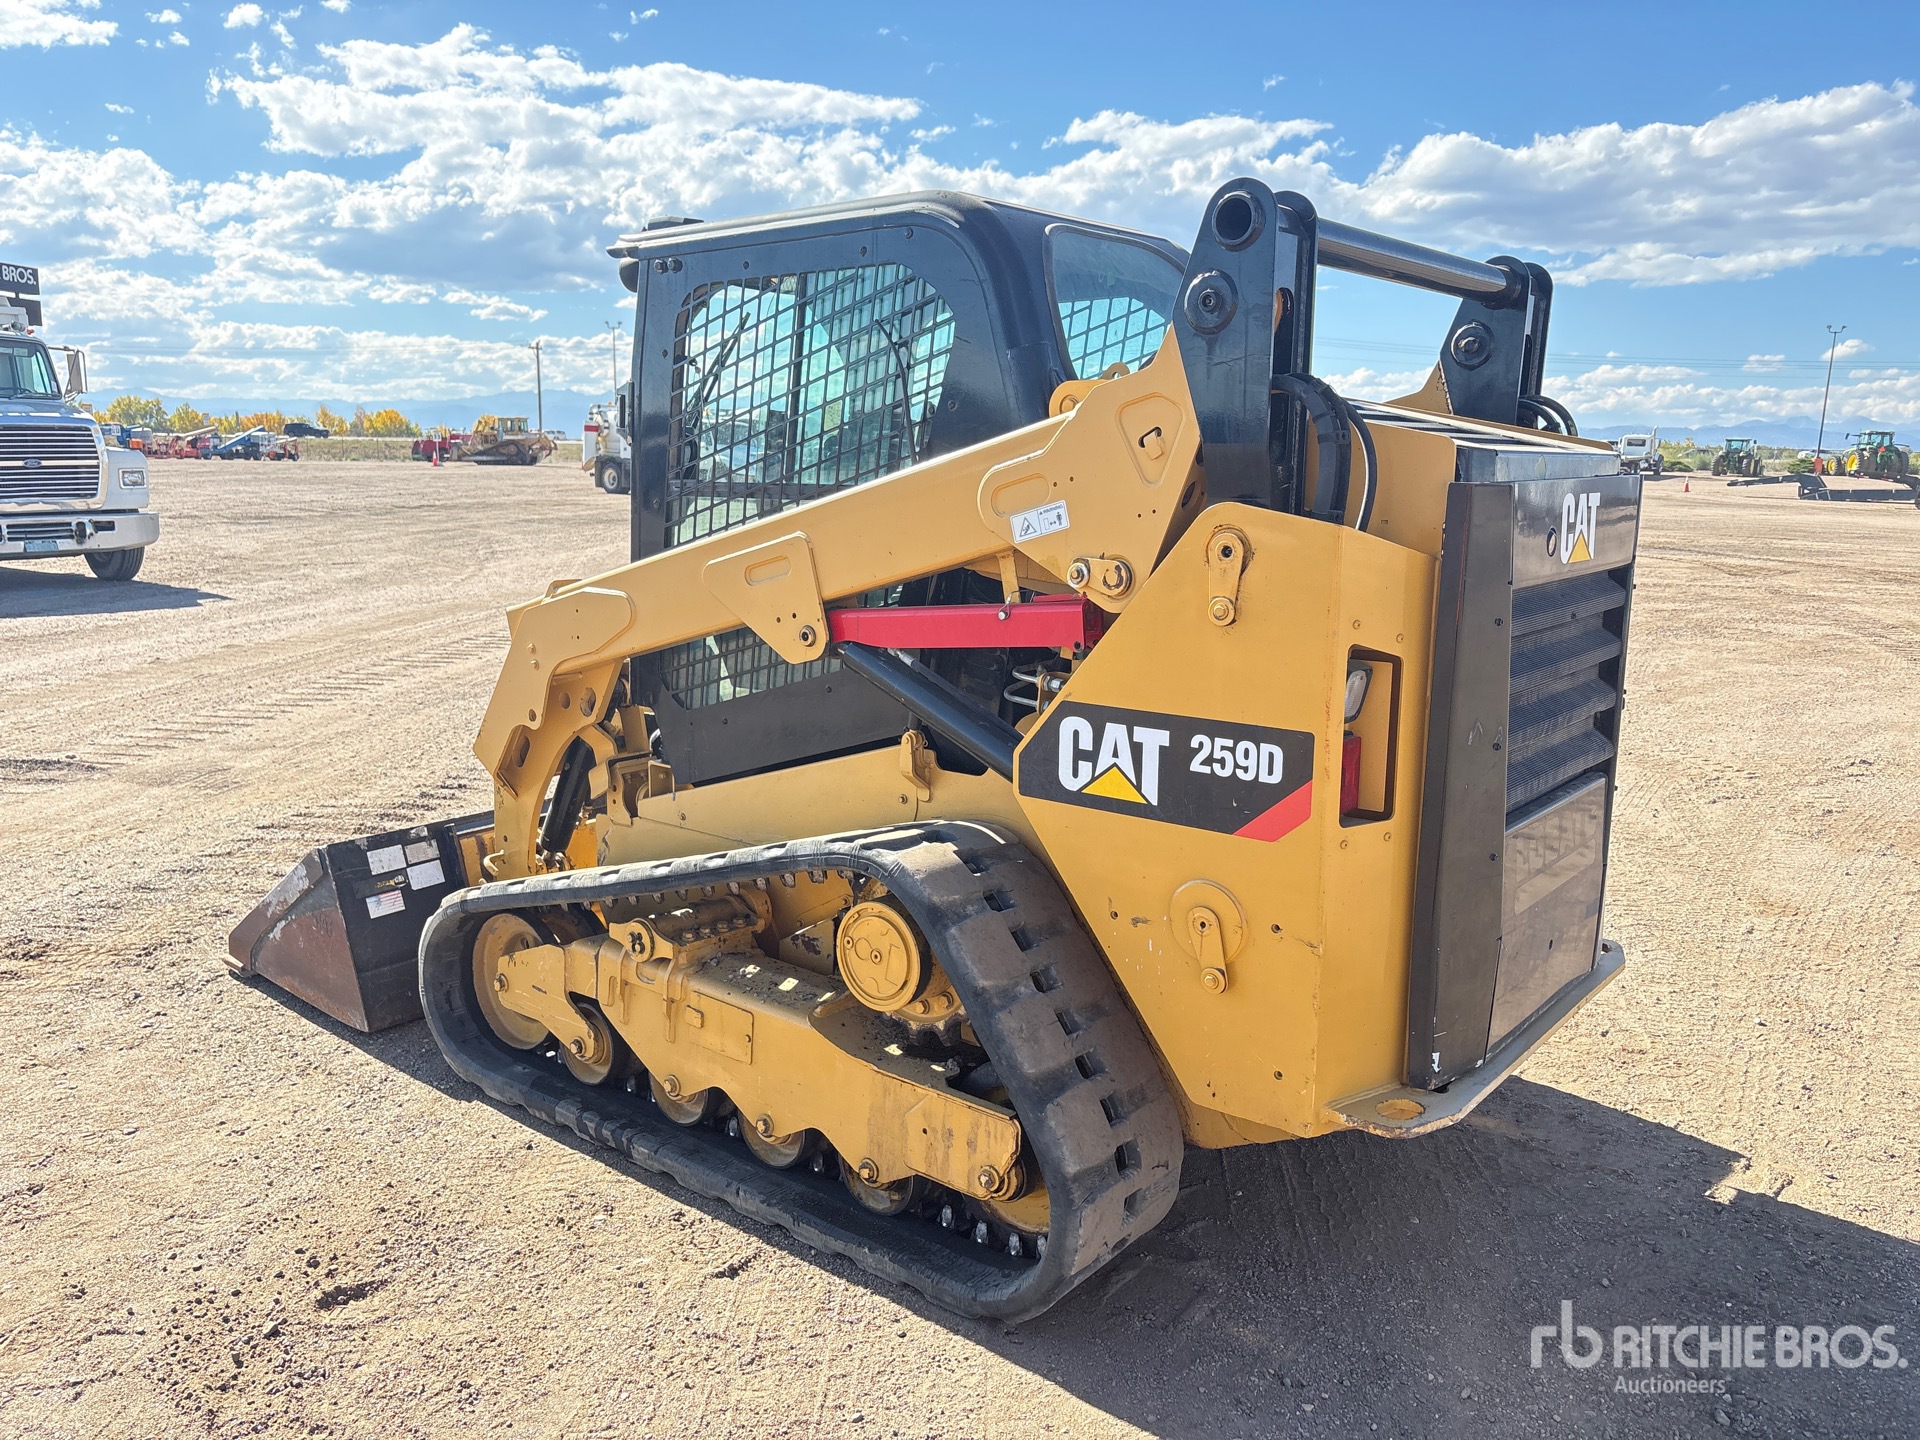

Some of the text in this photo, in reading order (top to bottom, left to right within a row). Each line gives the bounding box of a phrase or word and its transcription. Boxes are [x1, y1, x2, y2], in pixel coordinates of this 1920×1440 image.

[2, 265, 37, 285] BROS.
[1043, 504, 1063, 513] WARNING
[1560, 492, 1600, 565] CAT
[1058, 716, 1284, 806] CAT 259D
